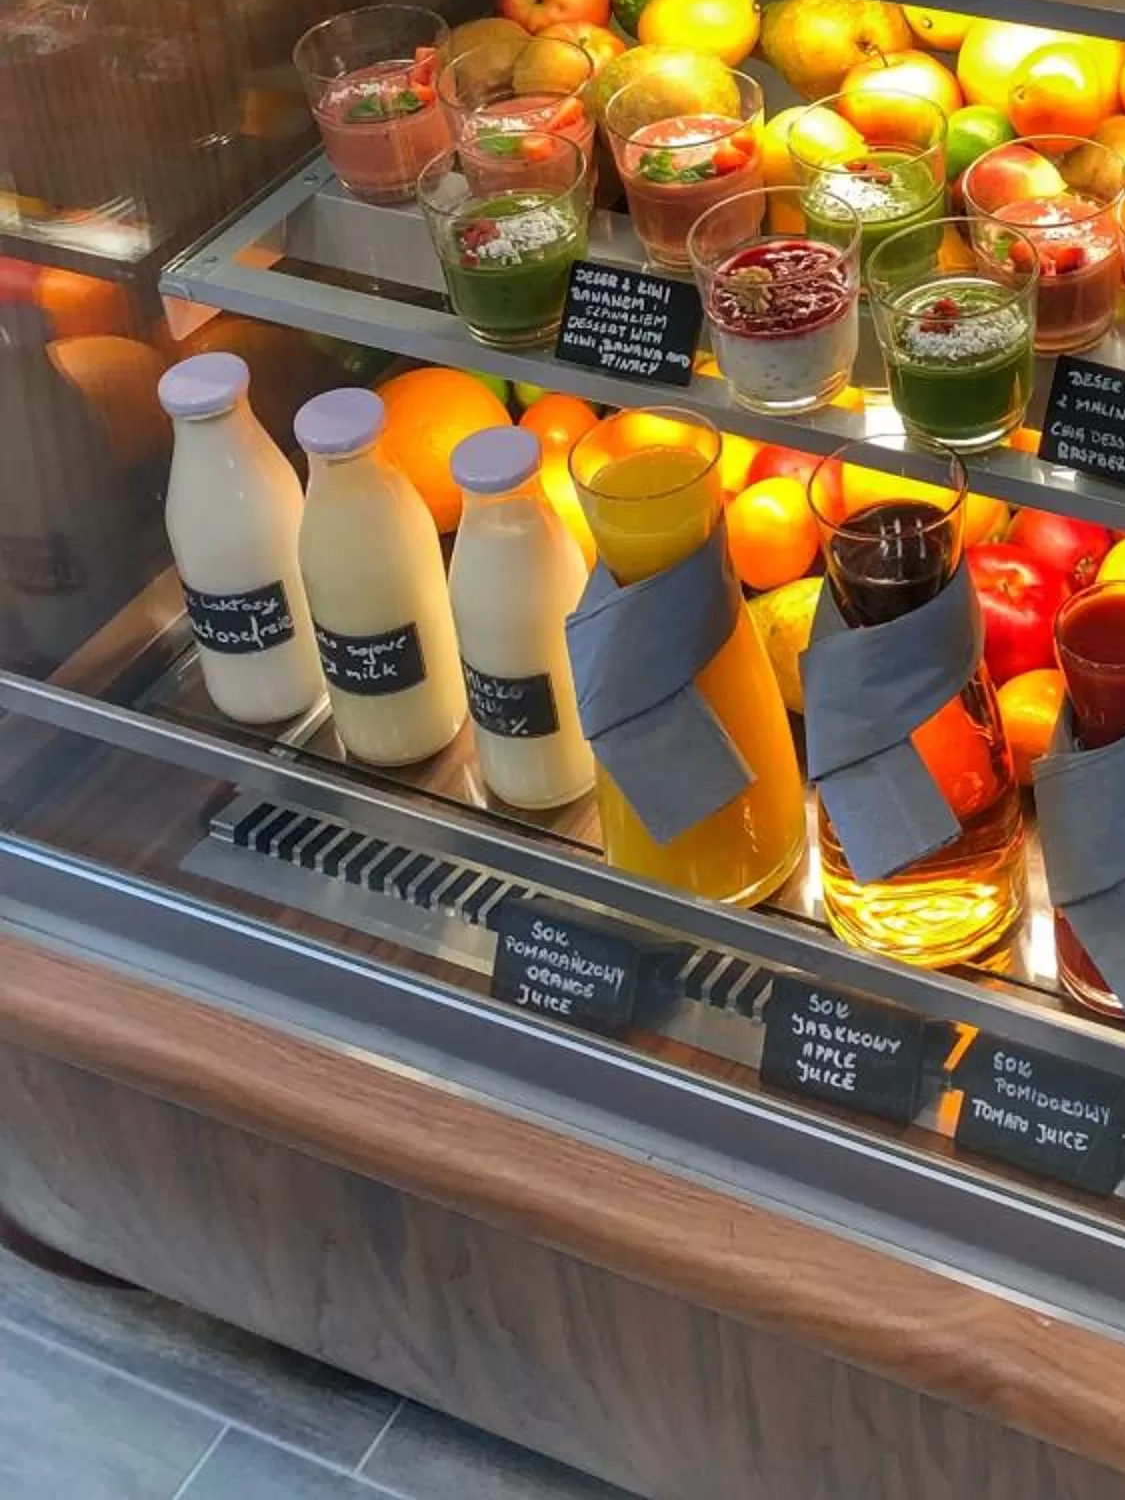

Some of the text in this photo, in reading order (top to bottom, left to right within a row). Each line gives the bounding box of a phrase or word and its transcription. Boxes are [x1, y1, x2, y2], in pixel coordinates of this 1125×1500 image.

[1049, 420, 1086, 444] CHIA
[530, 920, 570, 948] SOK
[526, 964, 596, 999] ORANGE
[516, 983, 574, 1015] JUICE
[807, 993, 851, 1020] SOK
[803, 1041, 858, 1070] APPLE
[992, 1050, 1034, 1079] SOK
[796, 1059, 858, 1092] JUICE
[992, 1076, 1112, 1128] POMIDOROWY
[971, 1097, 1090, 1152] TOMATO JUICE
